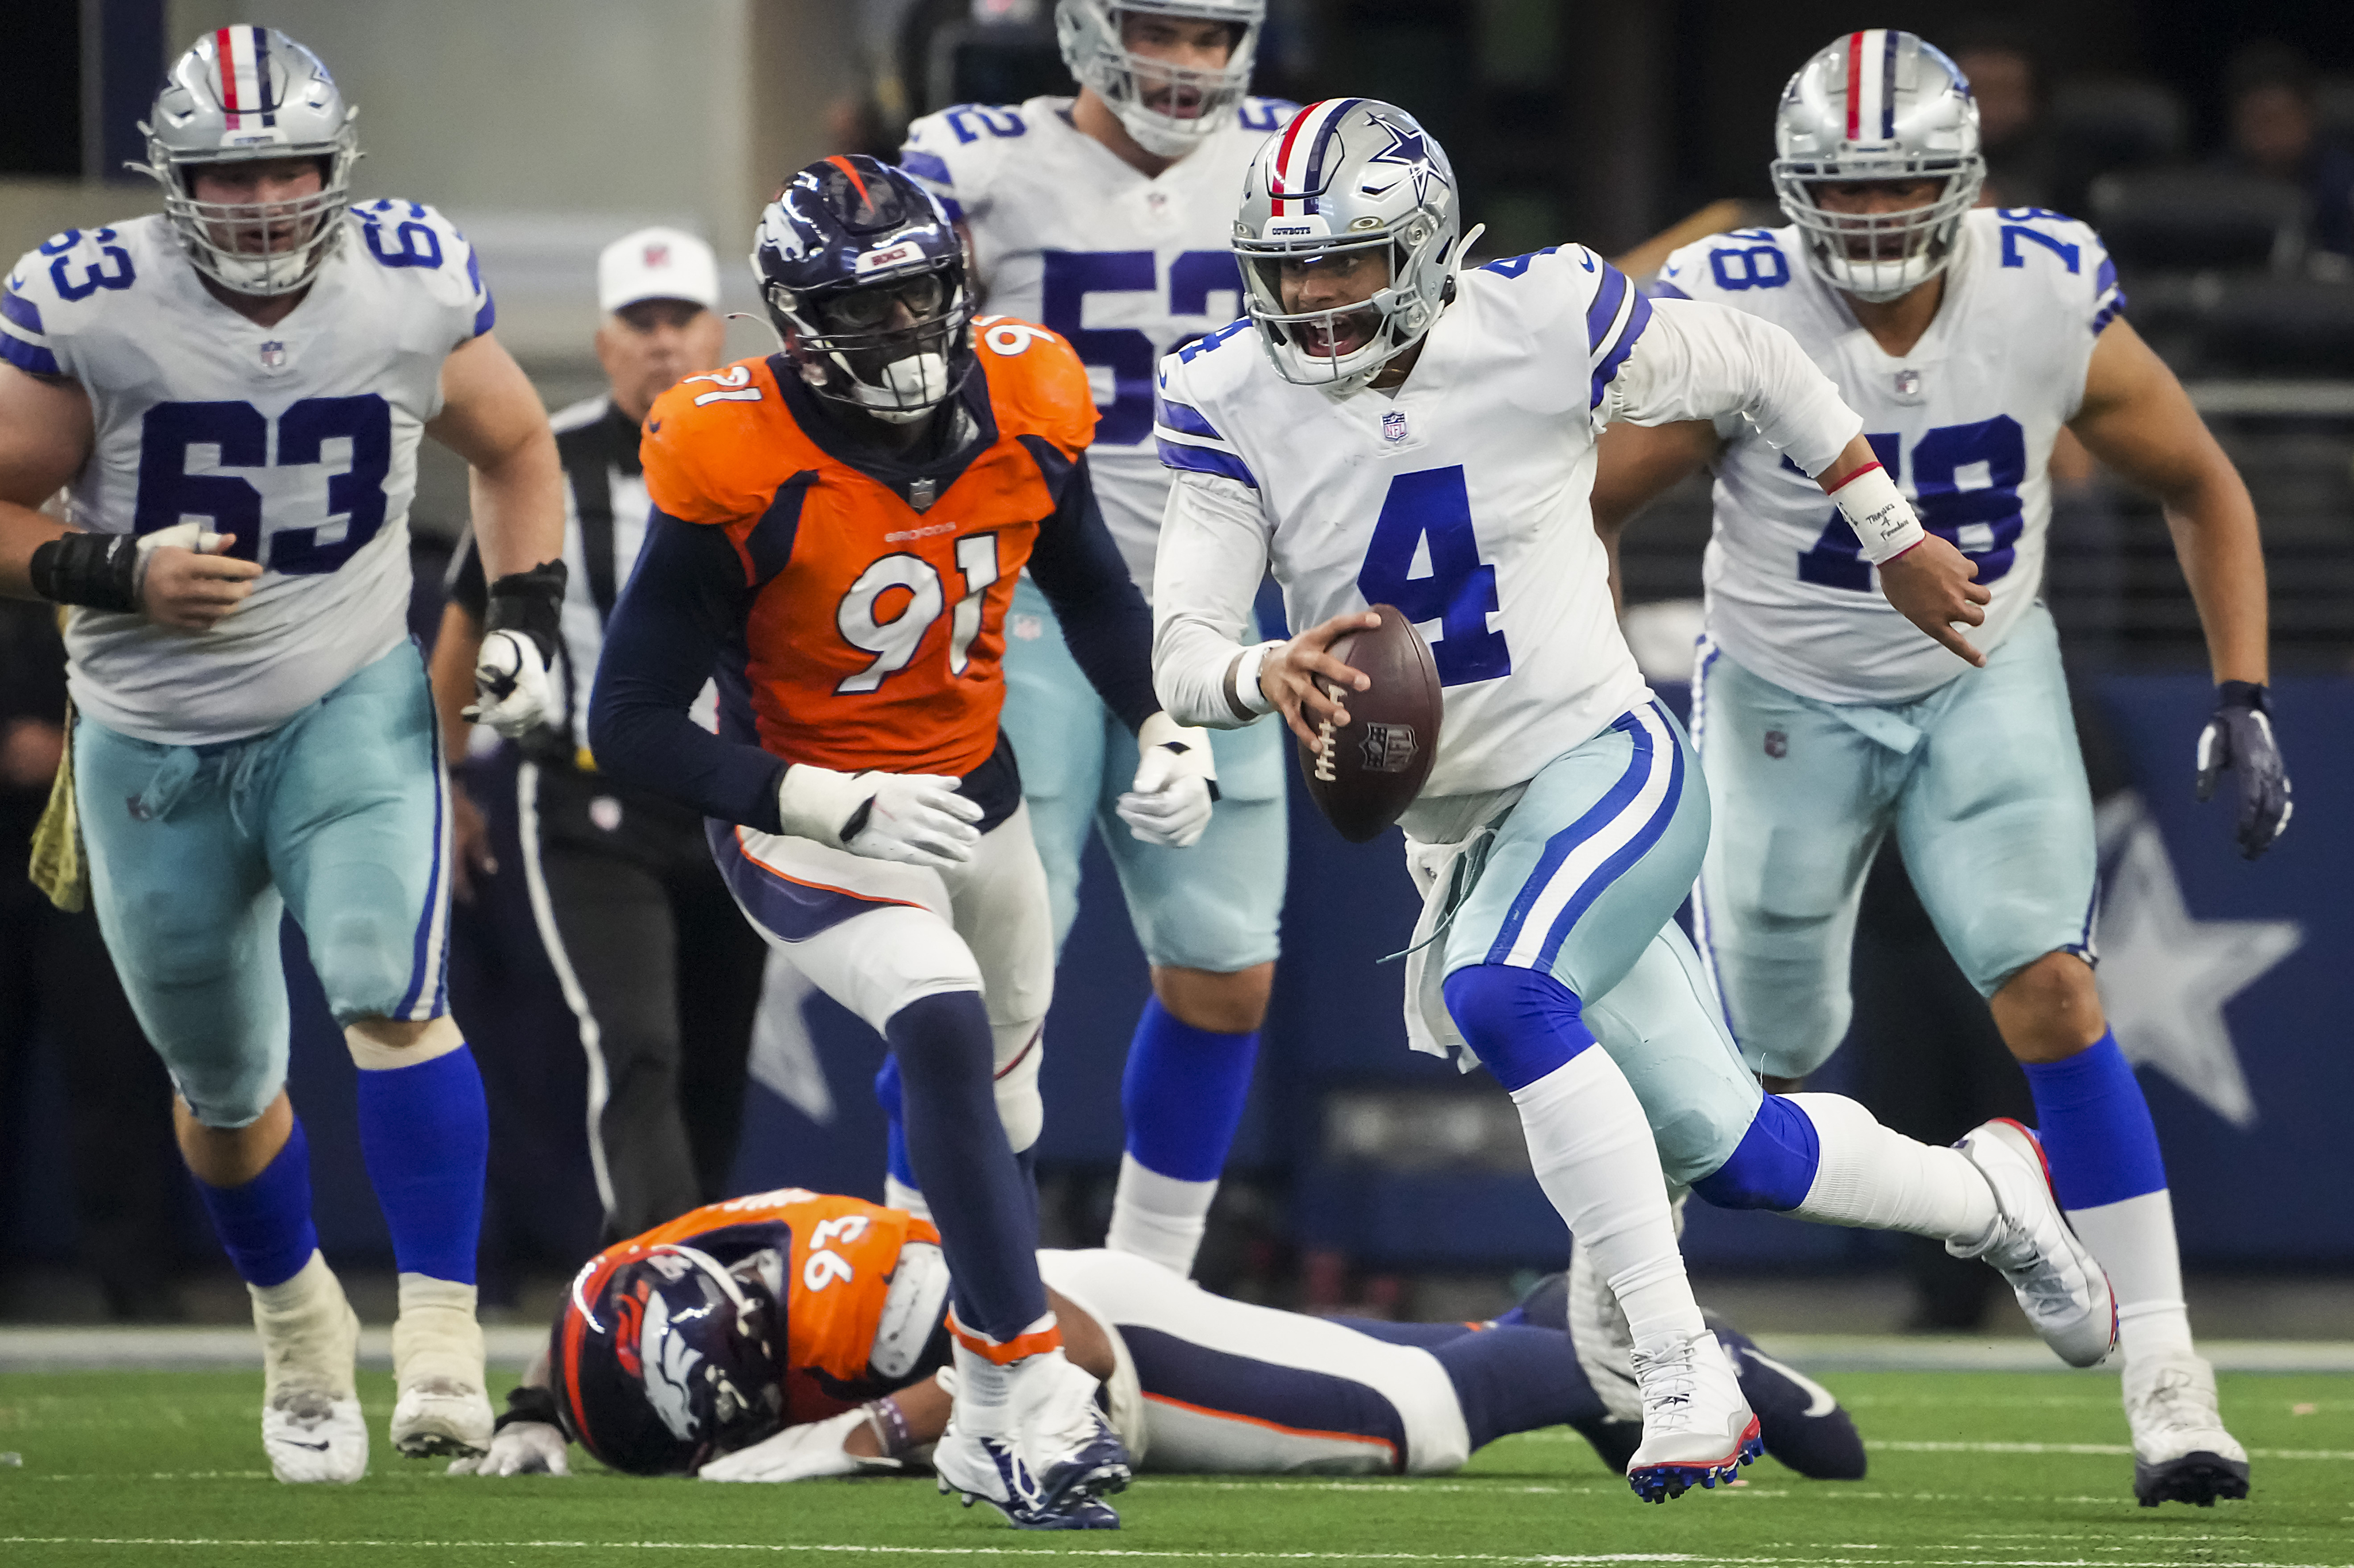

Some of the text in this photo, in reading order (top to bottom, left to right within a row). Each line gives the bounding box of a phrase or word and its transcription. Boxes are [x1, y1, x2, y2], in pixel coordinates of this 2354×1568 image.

[945, 104, 1028, 144] 2
[1272, 227, 1311, 235] COWBOYS
[133, 393, 392, 575] 63
[832, 531, 999, 696] 91
[1357, 464, 1511, 688] 4
[804, 1216, 870, 1292] 93
